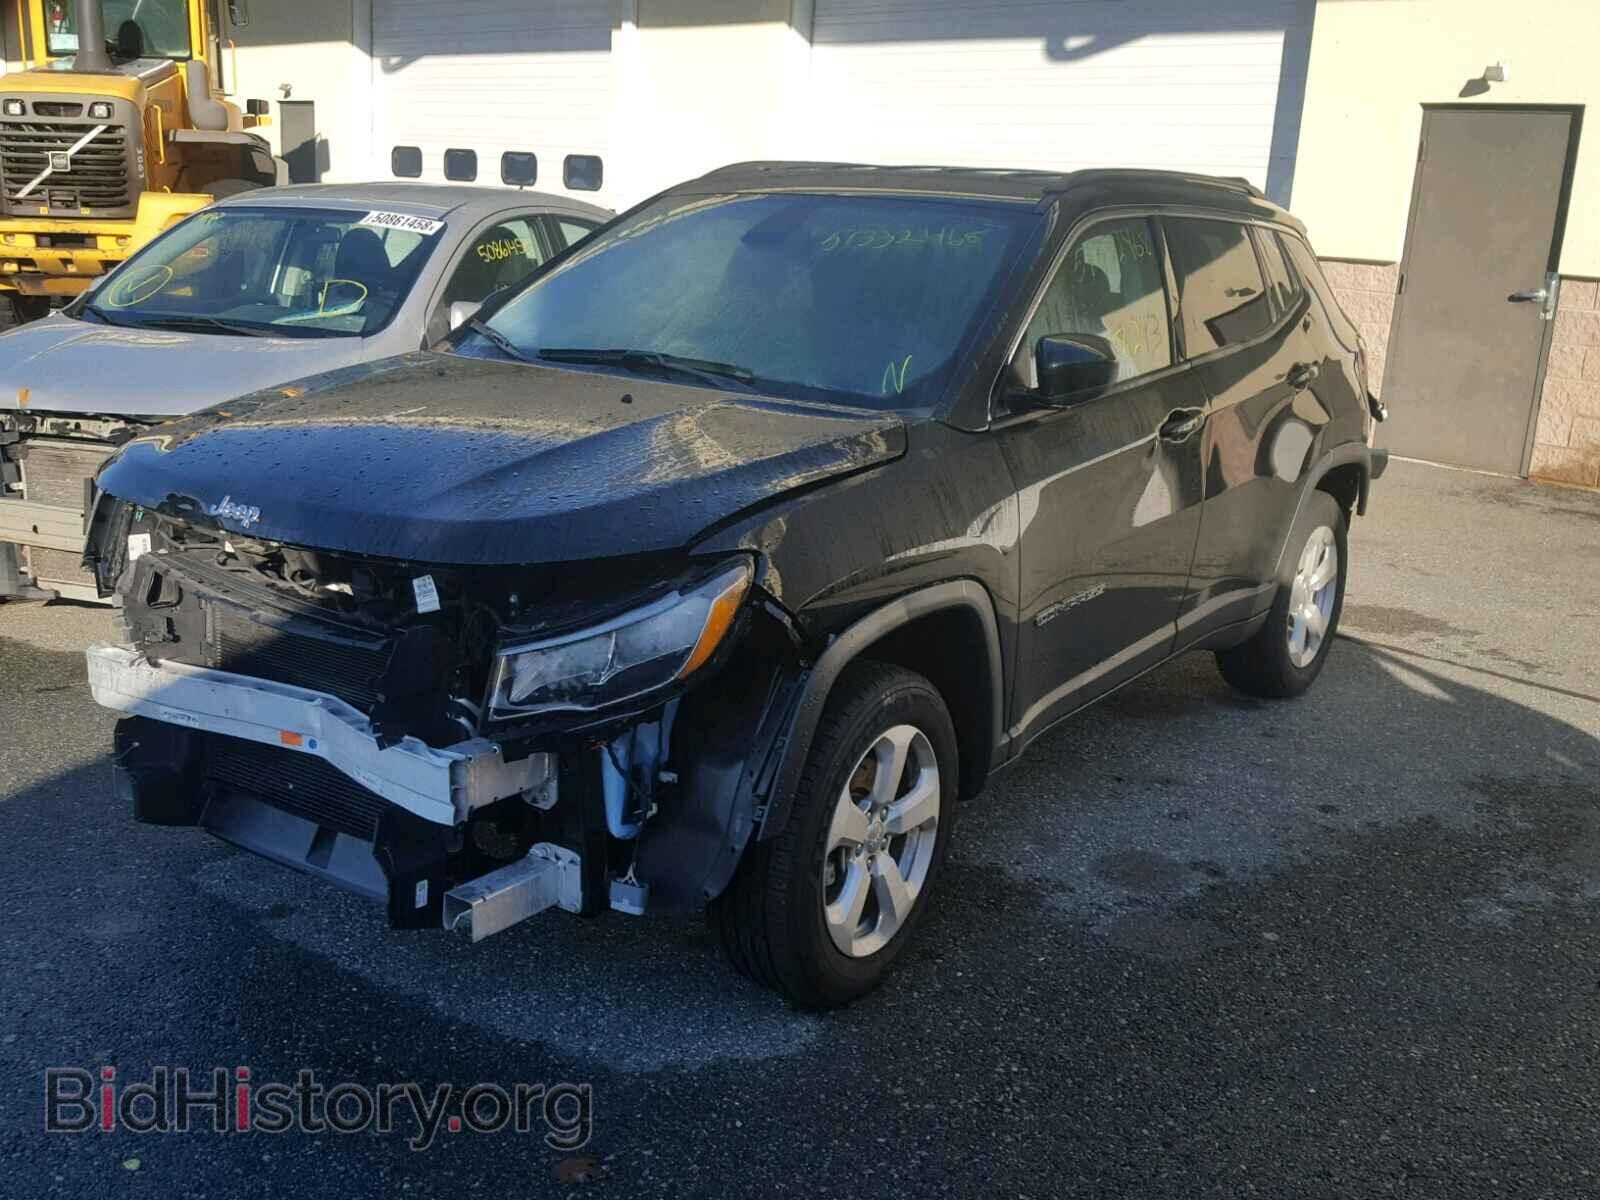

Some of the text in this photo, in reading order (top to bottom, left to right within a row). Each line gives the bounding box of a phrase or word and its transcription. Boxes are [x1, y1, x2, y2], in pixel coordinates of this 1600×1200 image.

[372, 213, 433, 231] 50861458
[882, 354, 912, 394] N
[209, 496, 260, 529] Jeep
